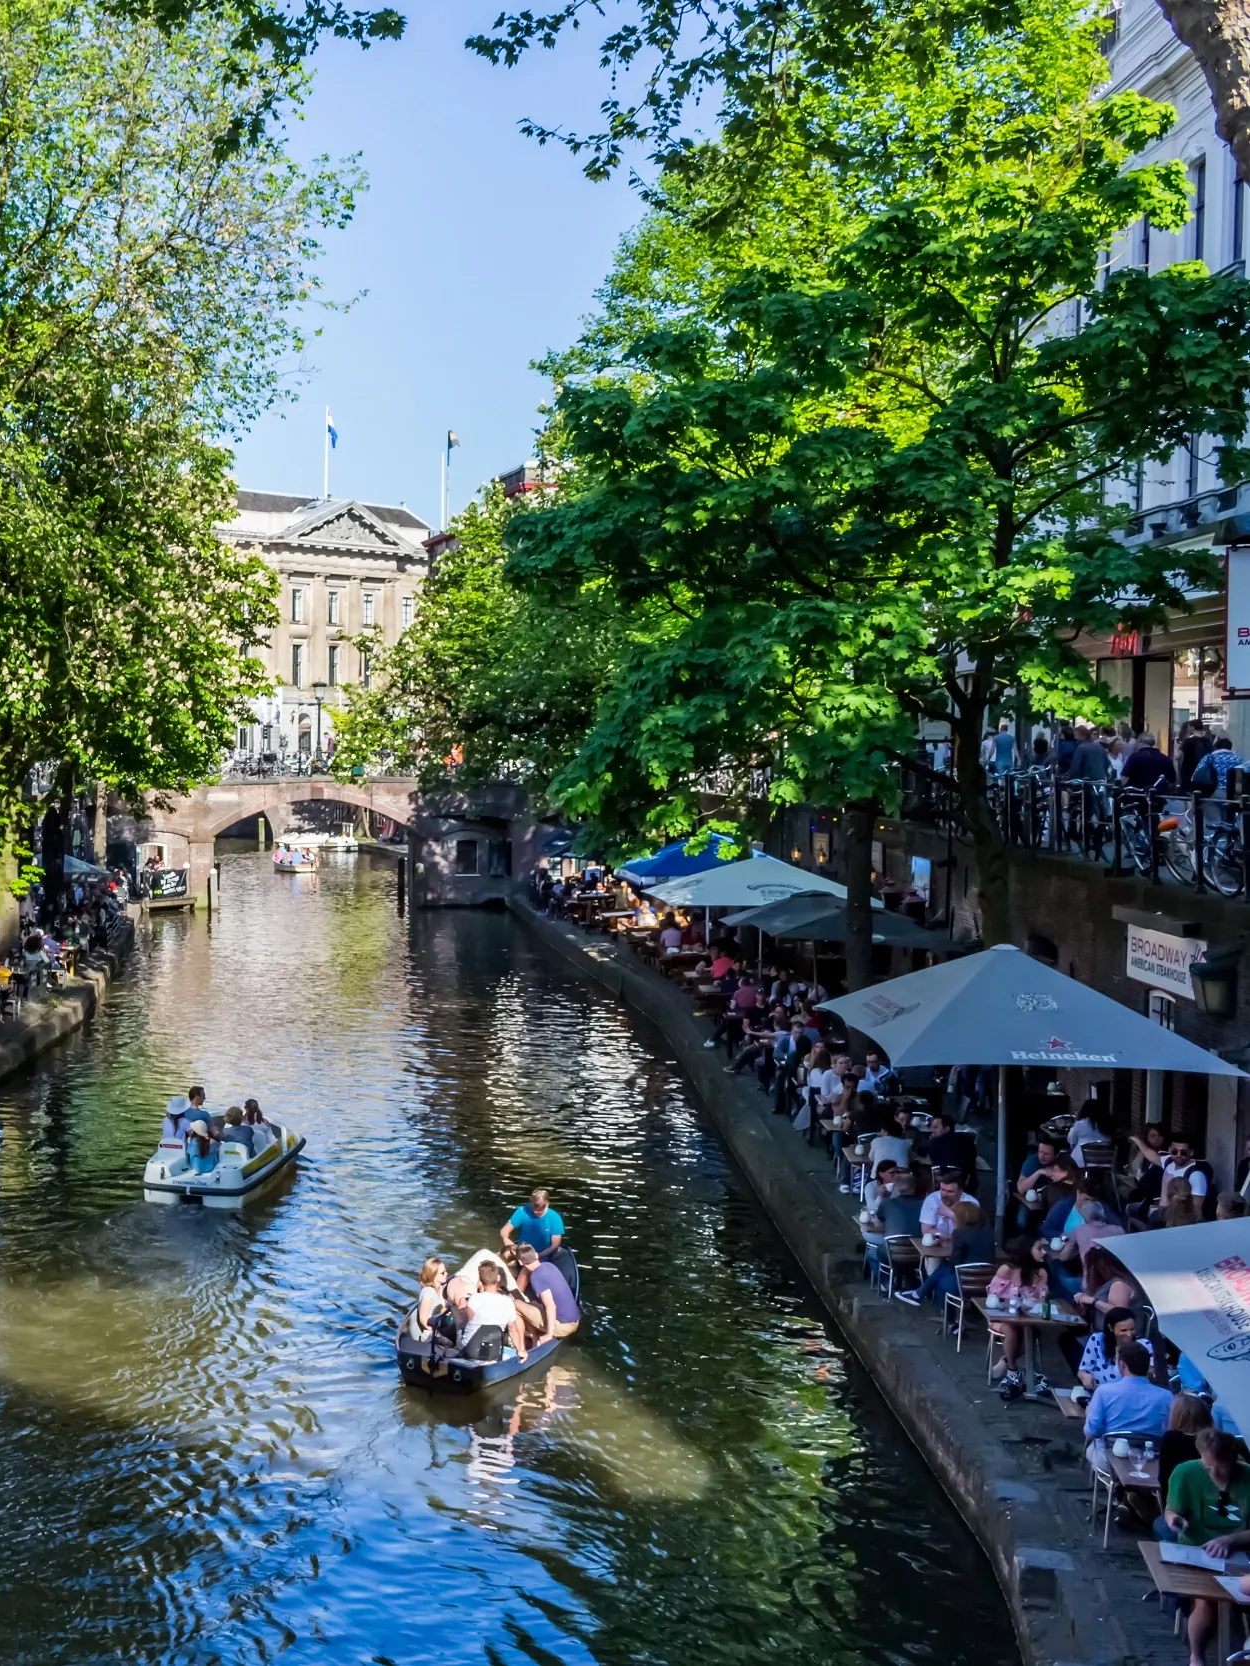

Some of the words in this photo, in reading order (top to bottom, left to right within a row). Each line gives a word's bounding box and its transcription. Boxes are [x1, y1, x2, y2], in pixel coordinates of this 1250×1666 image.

[1131, 937, 1188, 968] BROADWAY
[1131, 956, 1155, 973] AMERICAN
[1156, 963, 1187, 984] STEAKHOUSE
[1010, 1050, 1117, 1063] Heineken
